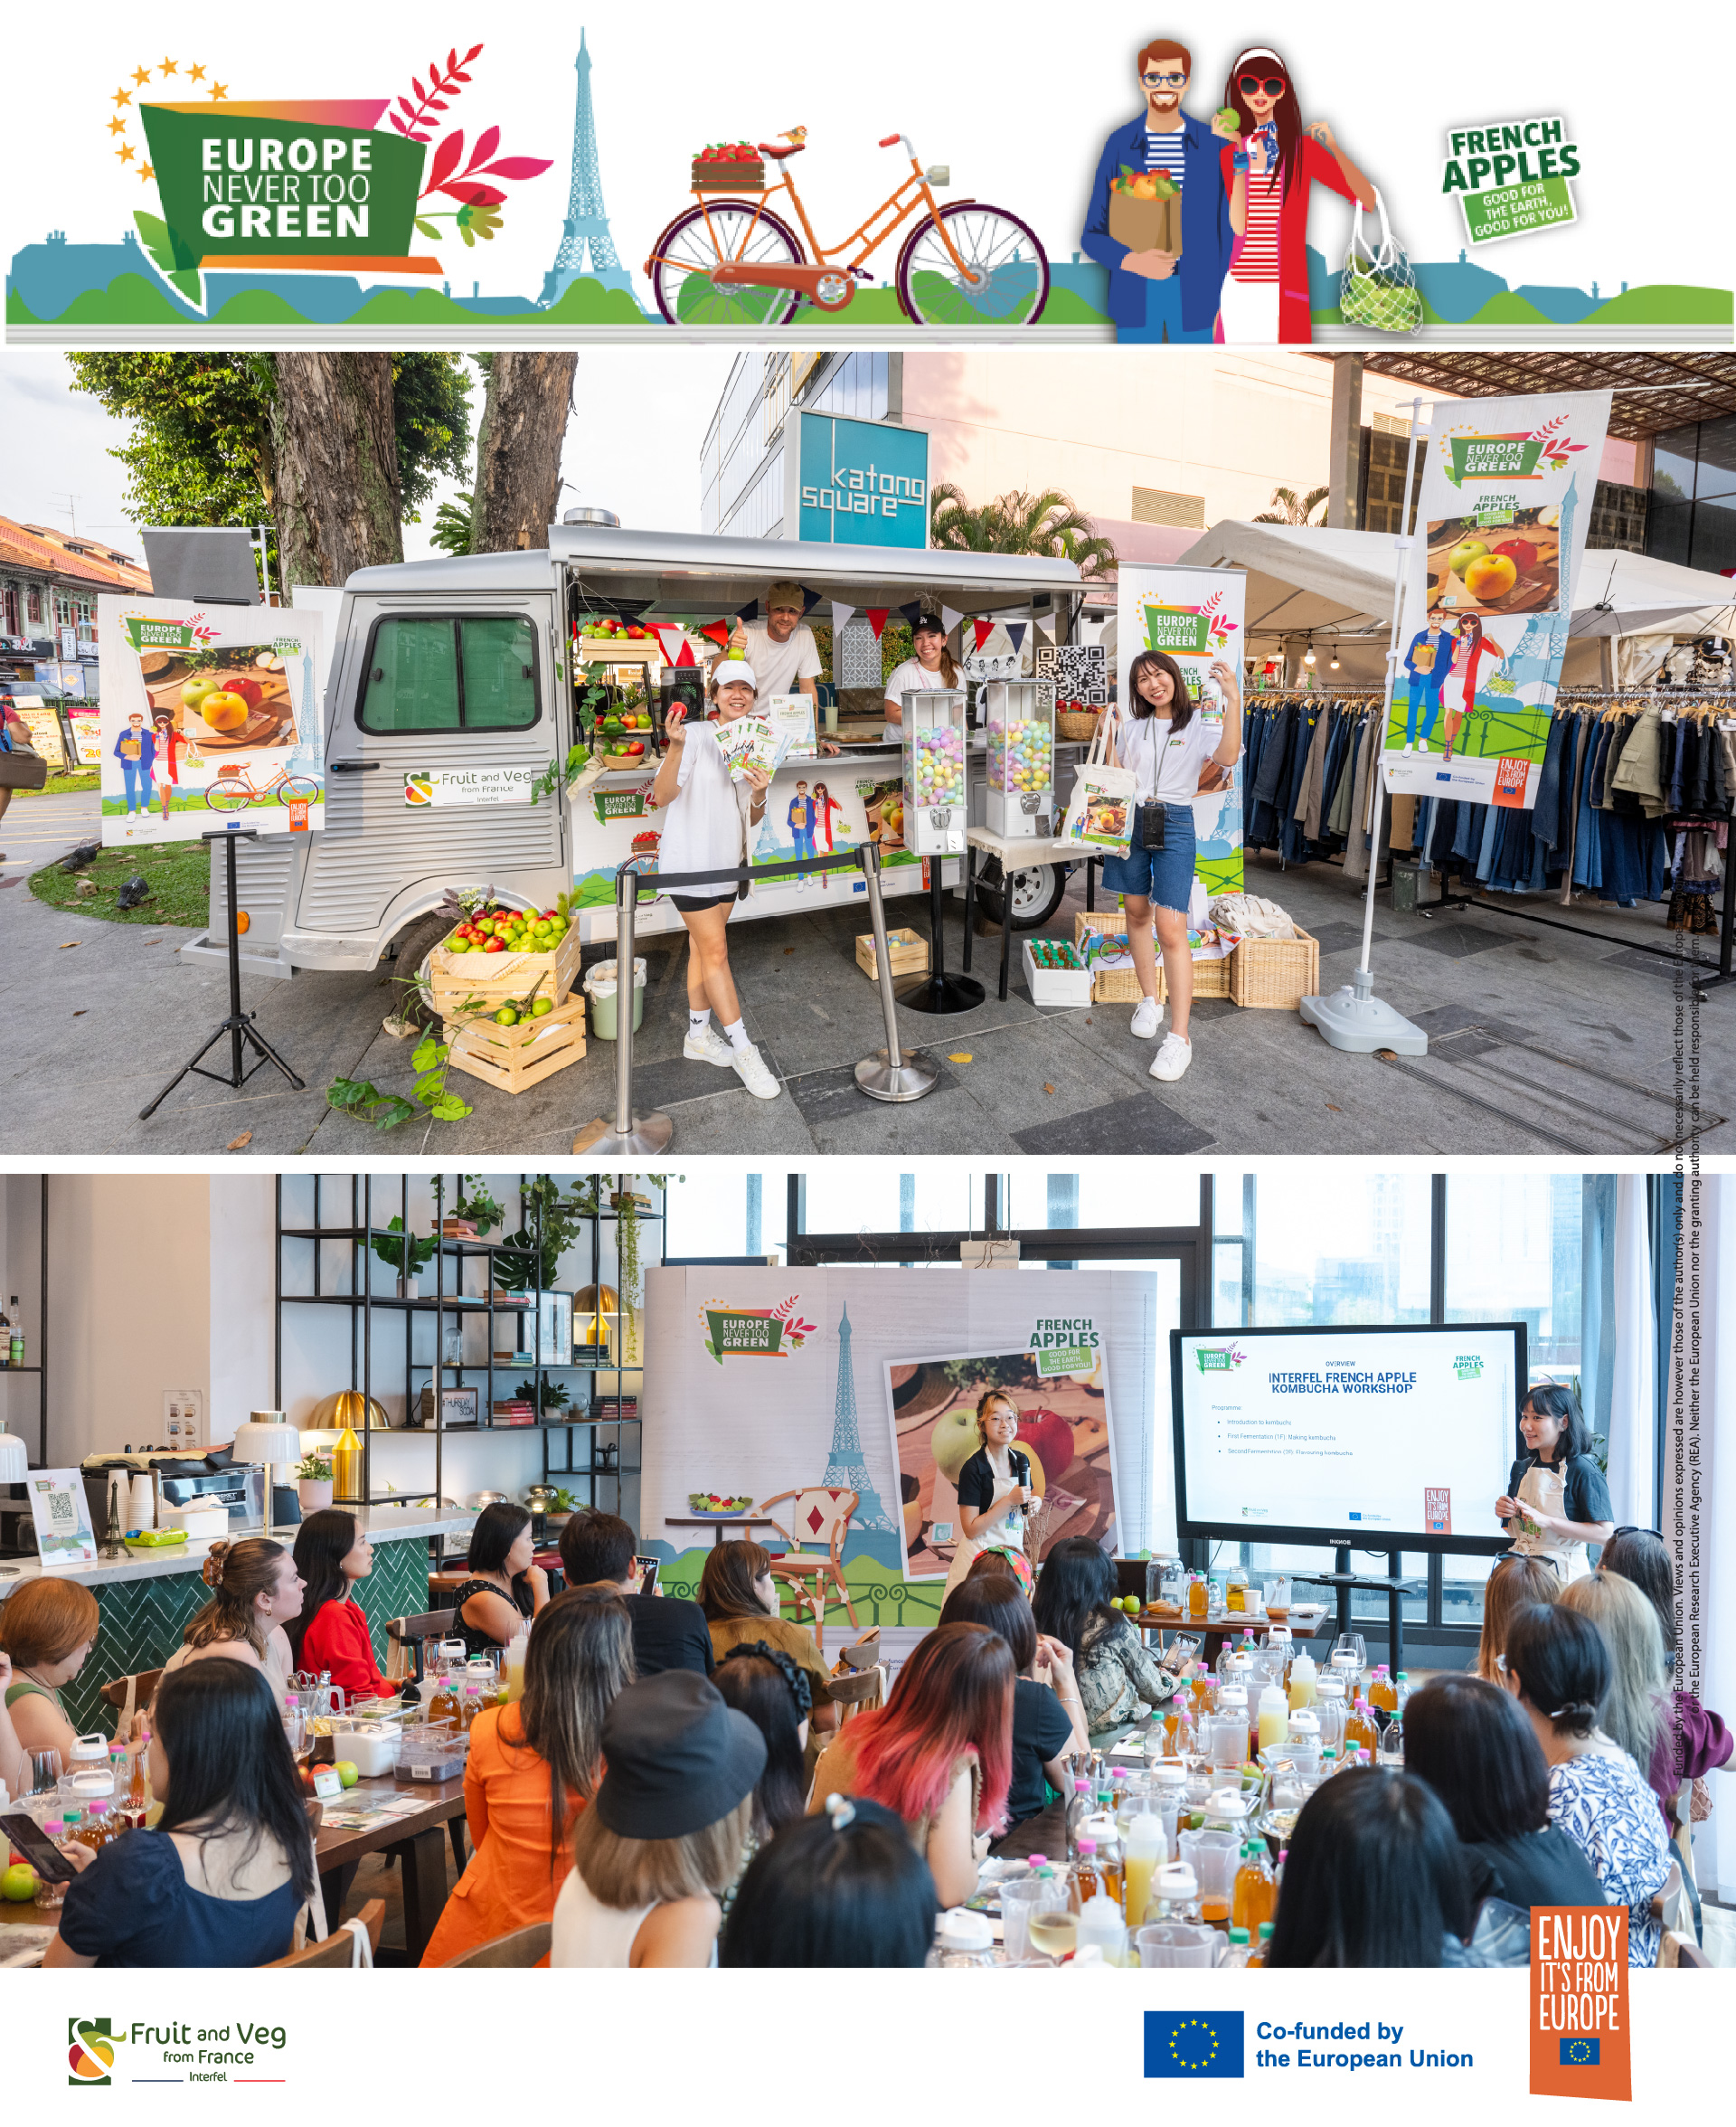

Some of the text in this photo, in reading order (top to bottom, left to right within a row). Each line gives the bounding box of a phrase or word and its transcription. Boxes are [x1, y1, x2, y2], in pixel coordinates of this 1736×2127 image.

[1467, 442, 1525, 454] EUROPE
[1467, 453, 1523, 463] NEVER TOO
[1465, 461, 1521, 472] GREEN
[831, 464, 925, 506] katong
[802, 486, 897, 518] square
[1472, 502, 1520, 511] APPLES
[1157, 615, 1198, 627] EUROPE
[141, 624, 182, 633] EUROPE
[1157, 627, 1197, 636] NEVER TOO
[141, 636, 182, 644] GREEN
[1157, 635, 1197, 646] GREEN
[1500, 758, 1528, 770] ENJOY
[442, 770, 532, 785] Fruit and Veg
[1500, 769, 1526, 779] IT'S FROM
[1497, 777, 1525, 788] EUROPE
[482, 785, 514, 793] France
[605, 796, 637, 804] EUROPE
[723, 1320, 769, 1328] EUROPE
[1036, 1319, 1092, 1330] FRENCH
[723, 1329, 769, 1338] NEVER TOO
[723, 1338, 769, 1347] GREEN
[1030, 1332, 1099, 1347] APPLES
[1049, 1350, 1067, 1358] GOOD
[1061, 1356, 1083, 1364] EARTH,
[1269, 1372, 1417, 1383] INTERFEL FRENCH APPLE
[1272, 1384, 1412, 1394] KOMBUCHA WORKSHOP
[1426, 1489, 1448, 1502] ENJOY
[1427, 1501, 1448, 1511] IT'S FROM
[1427, 1510, 1448, 1521] EUROPE
